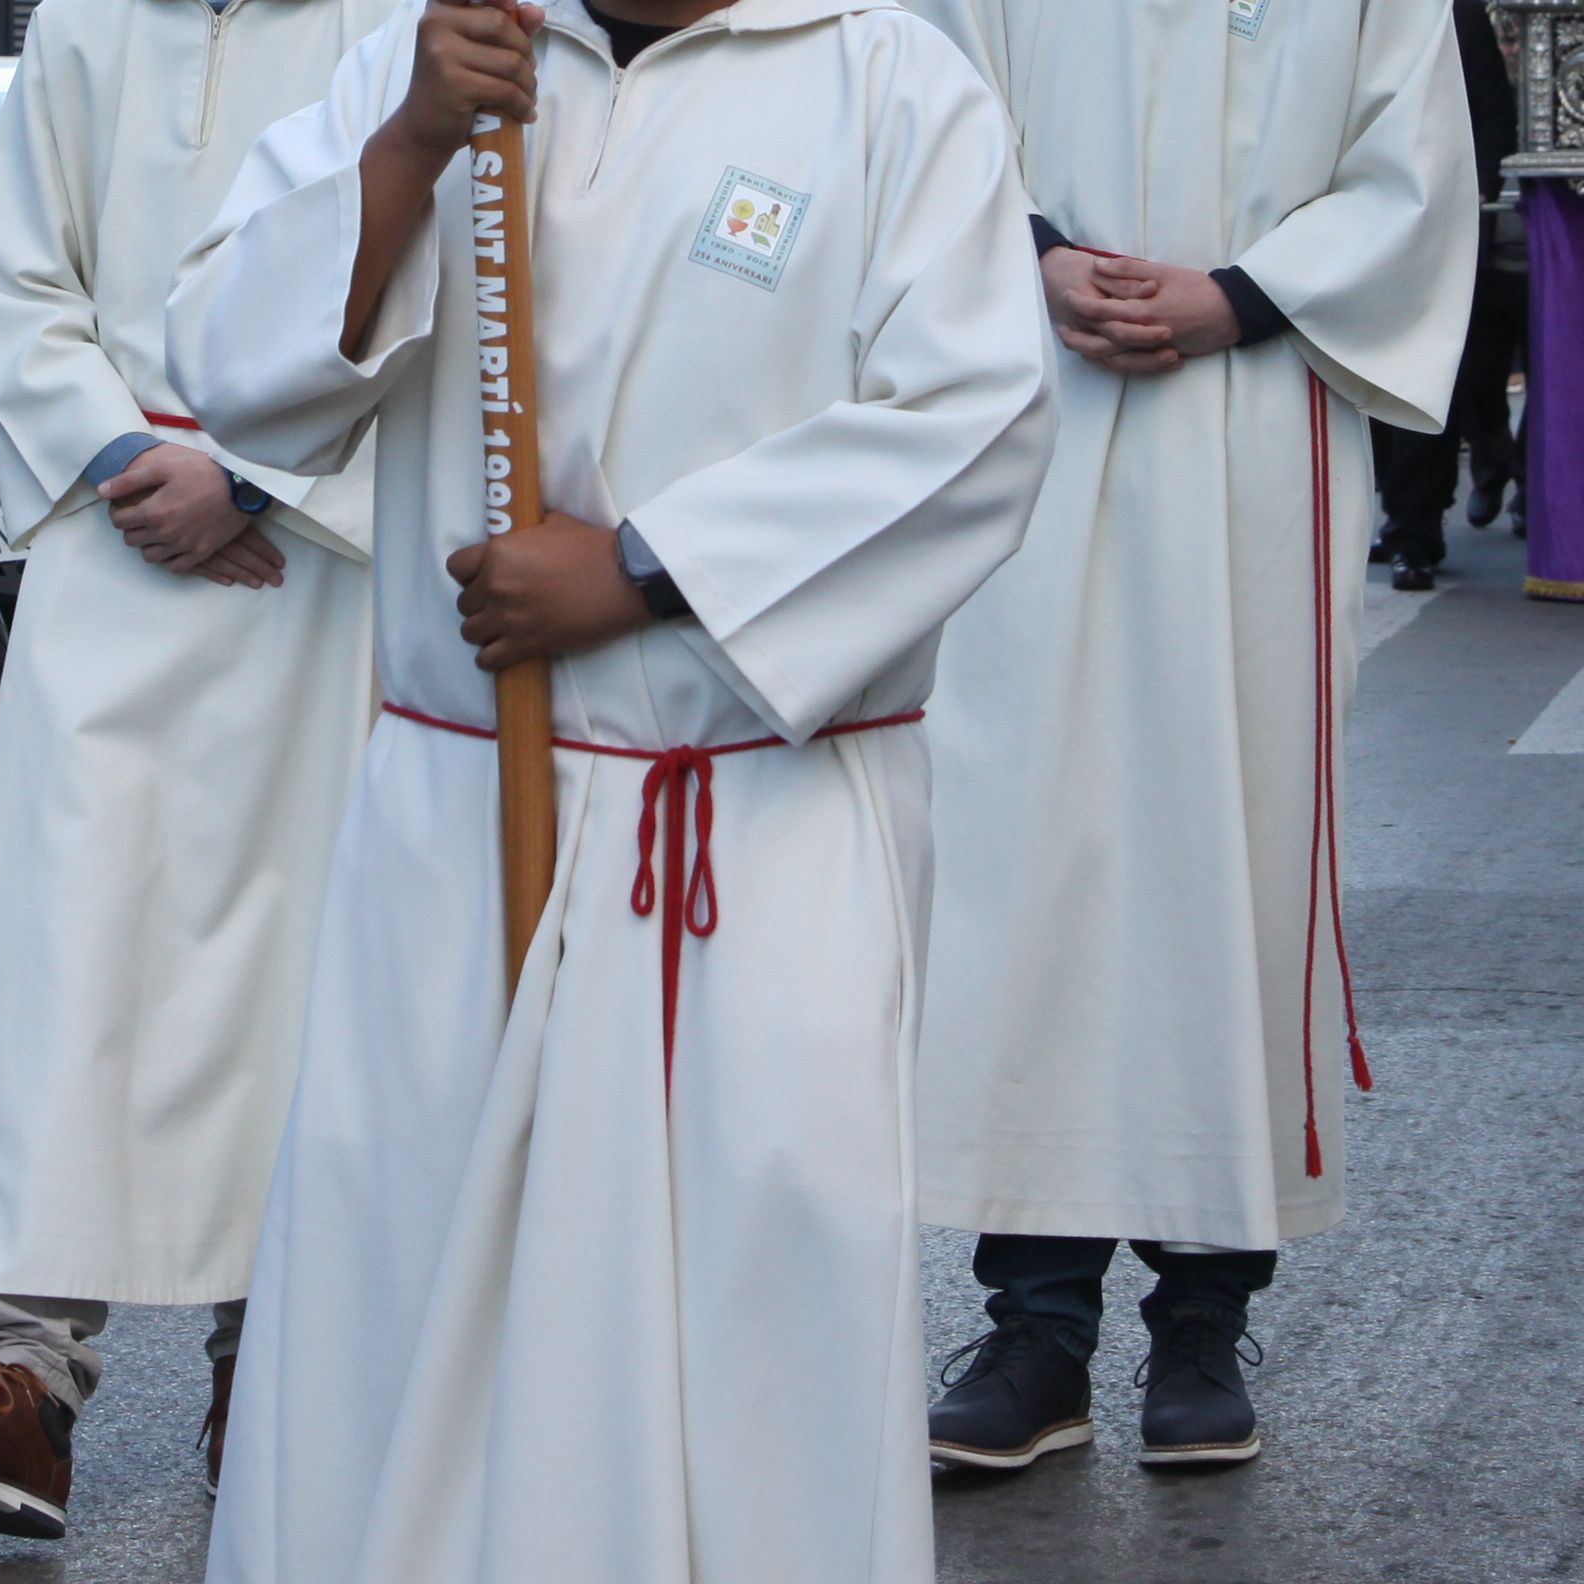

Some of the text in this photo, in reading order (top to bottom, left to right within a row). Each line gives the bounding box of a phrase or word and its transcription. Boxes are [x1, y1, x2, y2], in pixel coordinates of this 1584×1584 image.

[470, 149, 506, 264] SANT
[714, 257, 773, 285] ANIVERSARI
[476, 276, 523, 413] MARTÍ
